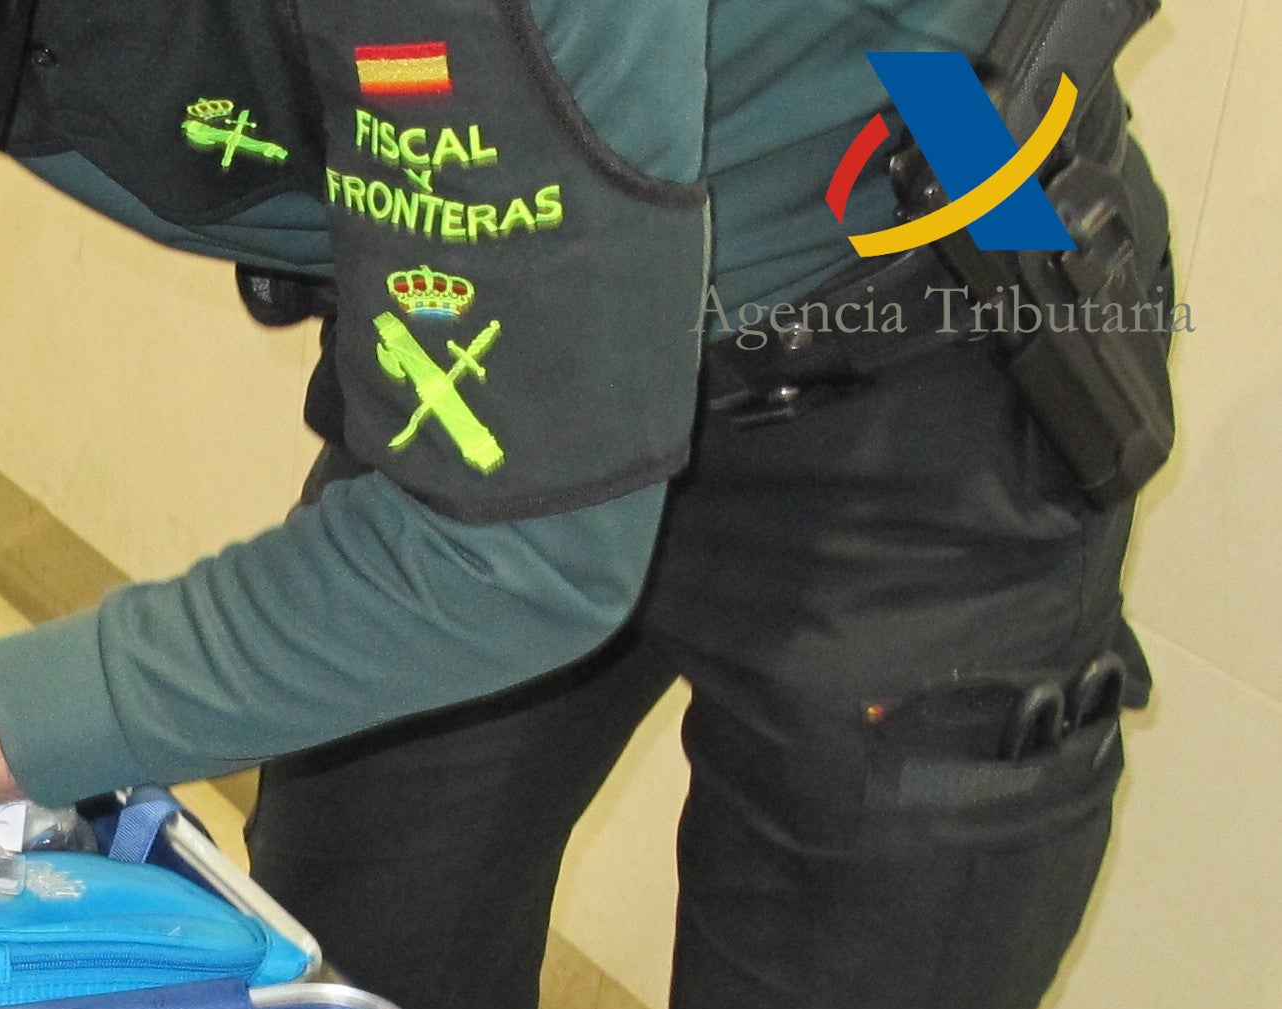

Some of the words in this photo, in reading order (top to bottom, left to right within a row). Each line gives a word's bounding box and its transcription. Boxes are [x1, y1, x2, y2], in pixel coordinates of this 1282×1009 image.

[355, 108, 499, 167] FISCAL
[325, 166, 564, 238] FRONTERAS
[401, 167, 434, 194] Y
